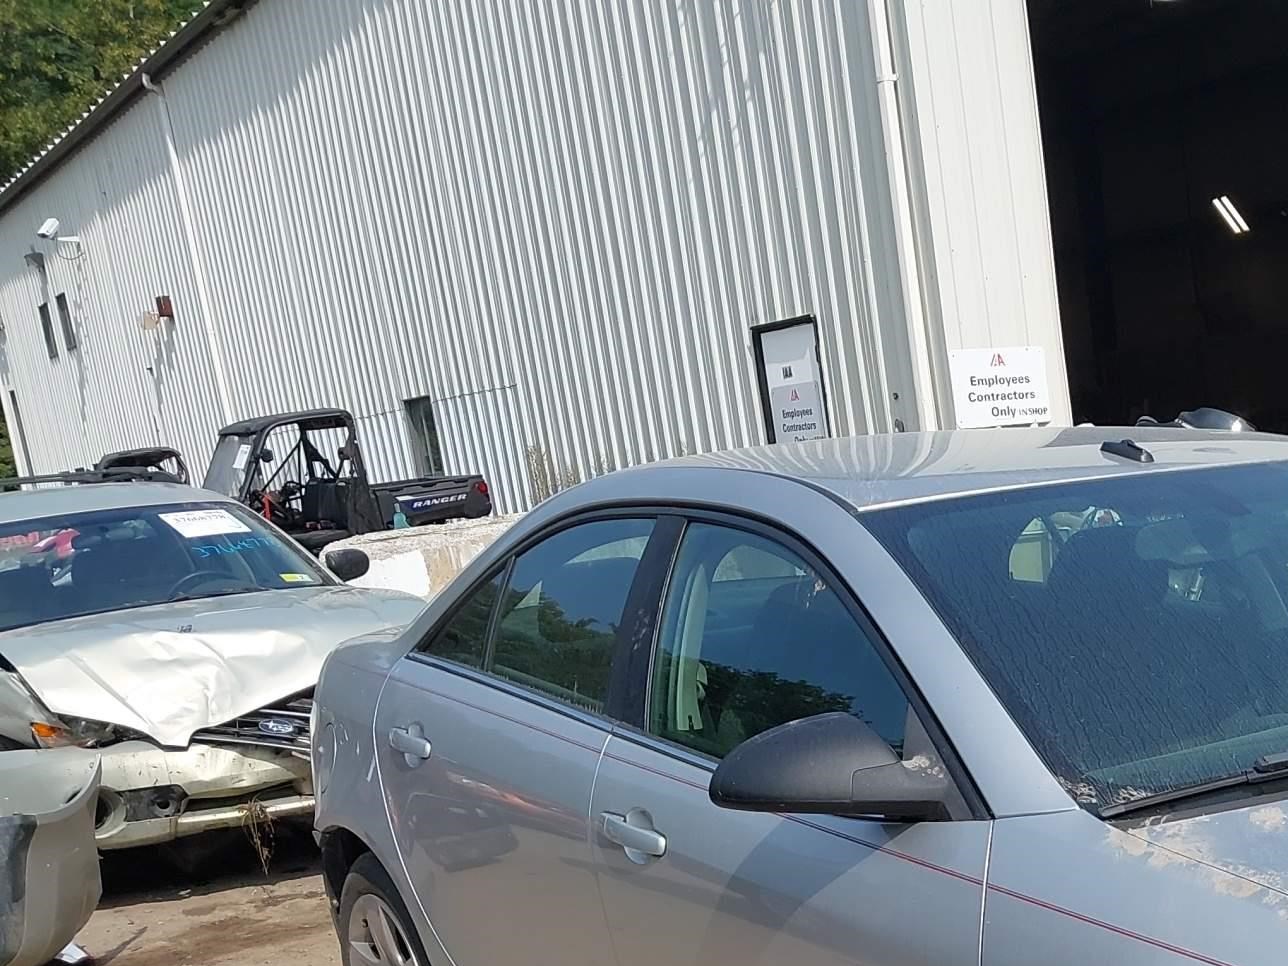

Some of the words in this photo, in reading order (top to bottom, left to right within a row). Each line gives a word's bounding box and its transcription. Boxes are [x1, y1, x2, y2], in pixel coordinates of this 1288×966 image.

[969, 374, 1031, 388] Employees
[968, 390, 1036, 403] Contractors
[782, 408, 813, 420] Employees
[991, 405, 1017, 418] Only
[782, 422, 817, 433] Contractors
[413, 494, 467, 509] RANGER
